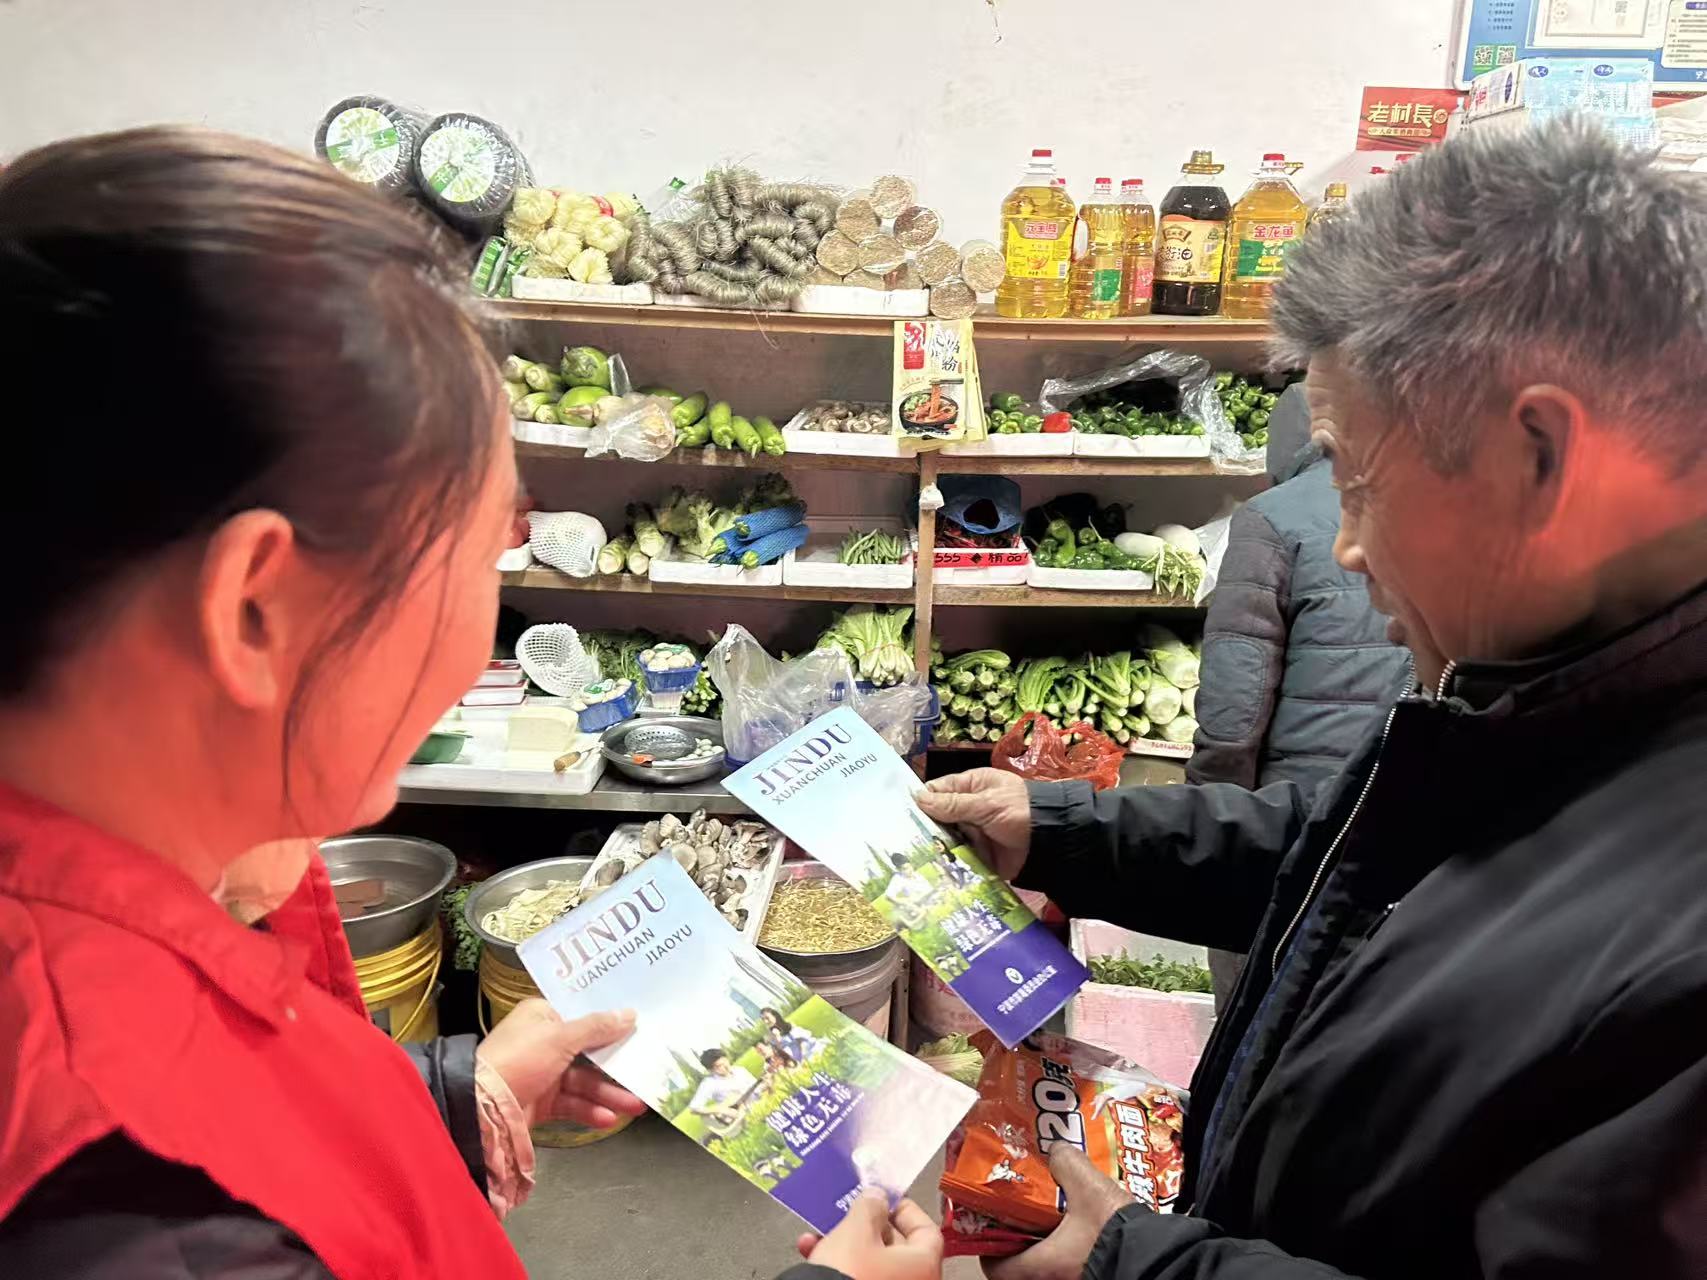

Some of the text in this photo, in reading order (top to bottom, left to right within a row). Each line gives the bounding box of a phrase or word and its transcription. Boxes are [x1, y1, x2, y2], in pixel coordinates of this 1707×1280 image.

[1367, 100, 1434, 128] 老村長
[1254, 225, 1295, 238] 金龙鱼
[752, 723, 852, 796] JINDU
[772, 752, 847, 805] XUANCHUAN
[840, 753, 878, 778] JIAOYU
[549, 880, 668, 978] JINDU
[644, 924, 693, 965] JIAOYU
